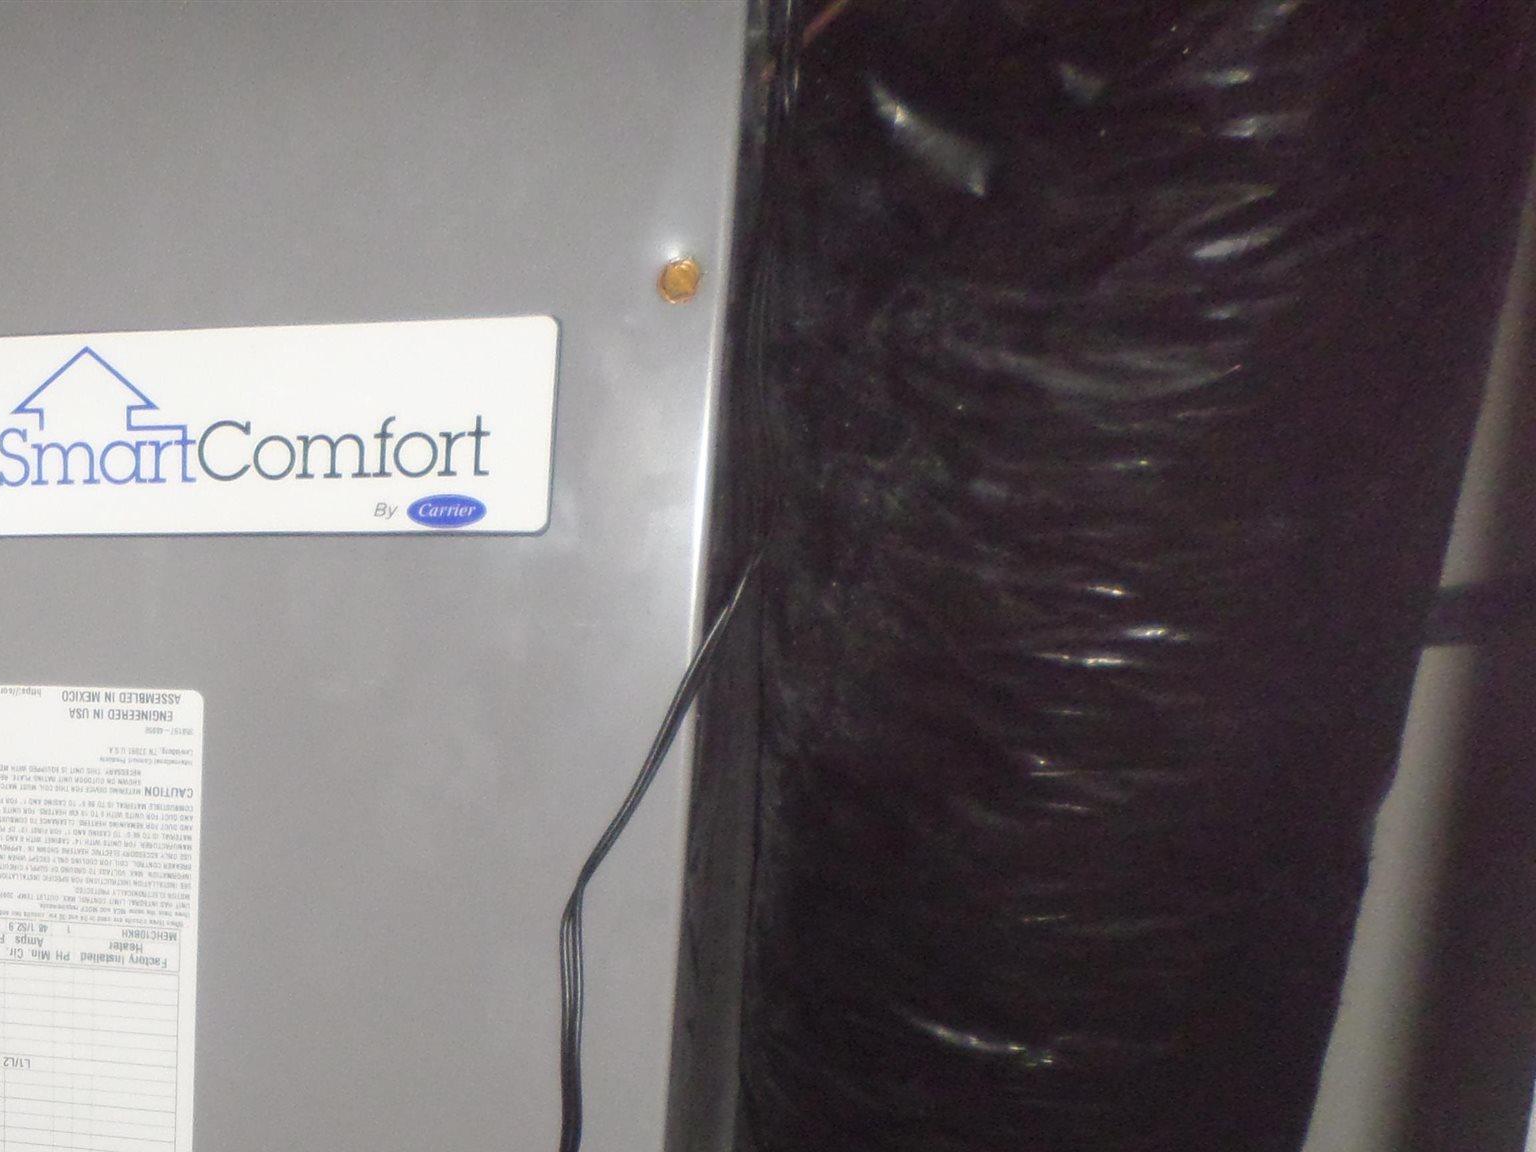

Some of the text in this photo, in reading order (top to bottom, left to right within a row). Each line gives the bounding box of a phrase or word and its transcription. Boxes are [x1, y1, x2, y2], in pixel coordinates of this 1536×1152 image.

[374, 502, 476, 520] By Carrier
[62, 690, 181, 705] ASSEMBLED IN MEXICO
[69, 708, 173, 722] ENGINEERED IN USA
[144, 786, 193, 799] CAUTION
[15, 934, 44, 947] Amps
[109, 941, 143, 953] Heater
[28, 949, 50, 960] Min.
[56, 950, 70, 961] PH
[80, 951, 167, 968] Factory Installed
[3, 1055, 31, 1069] L1/L2
